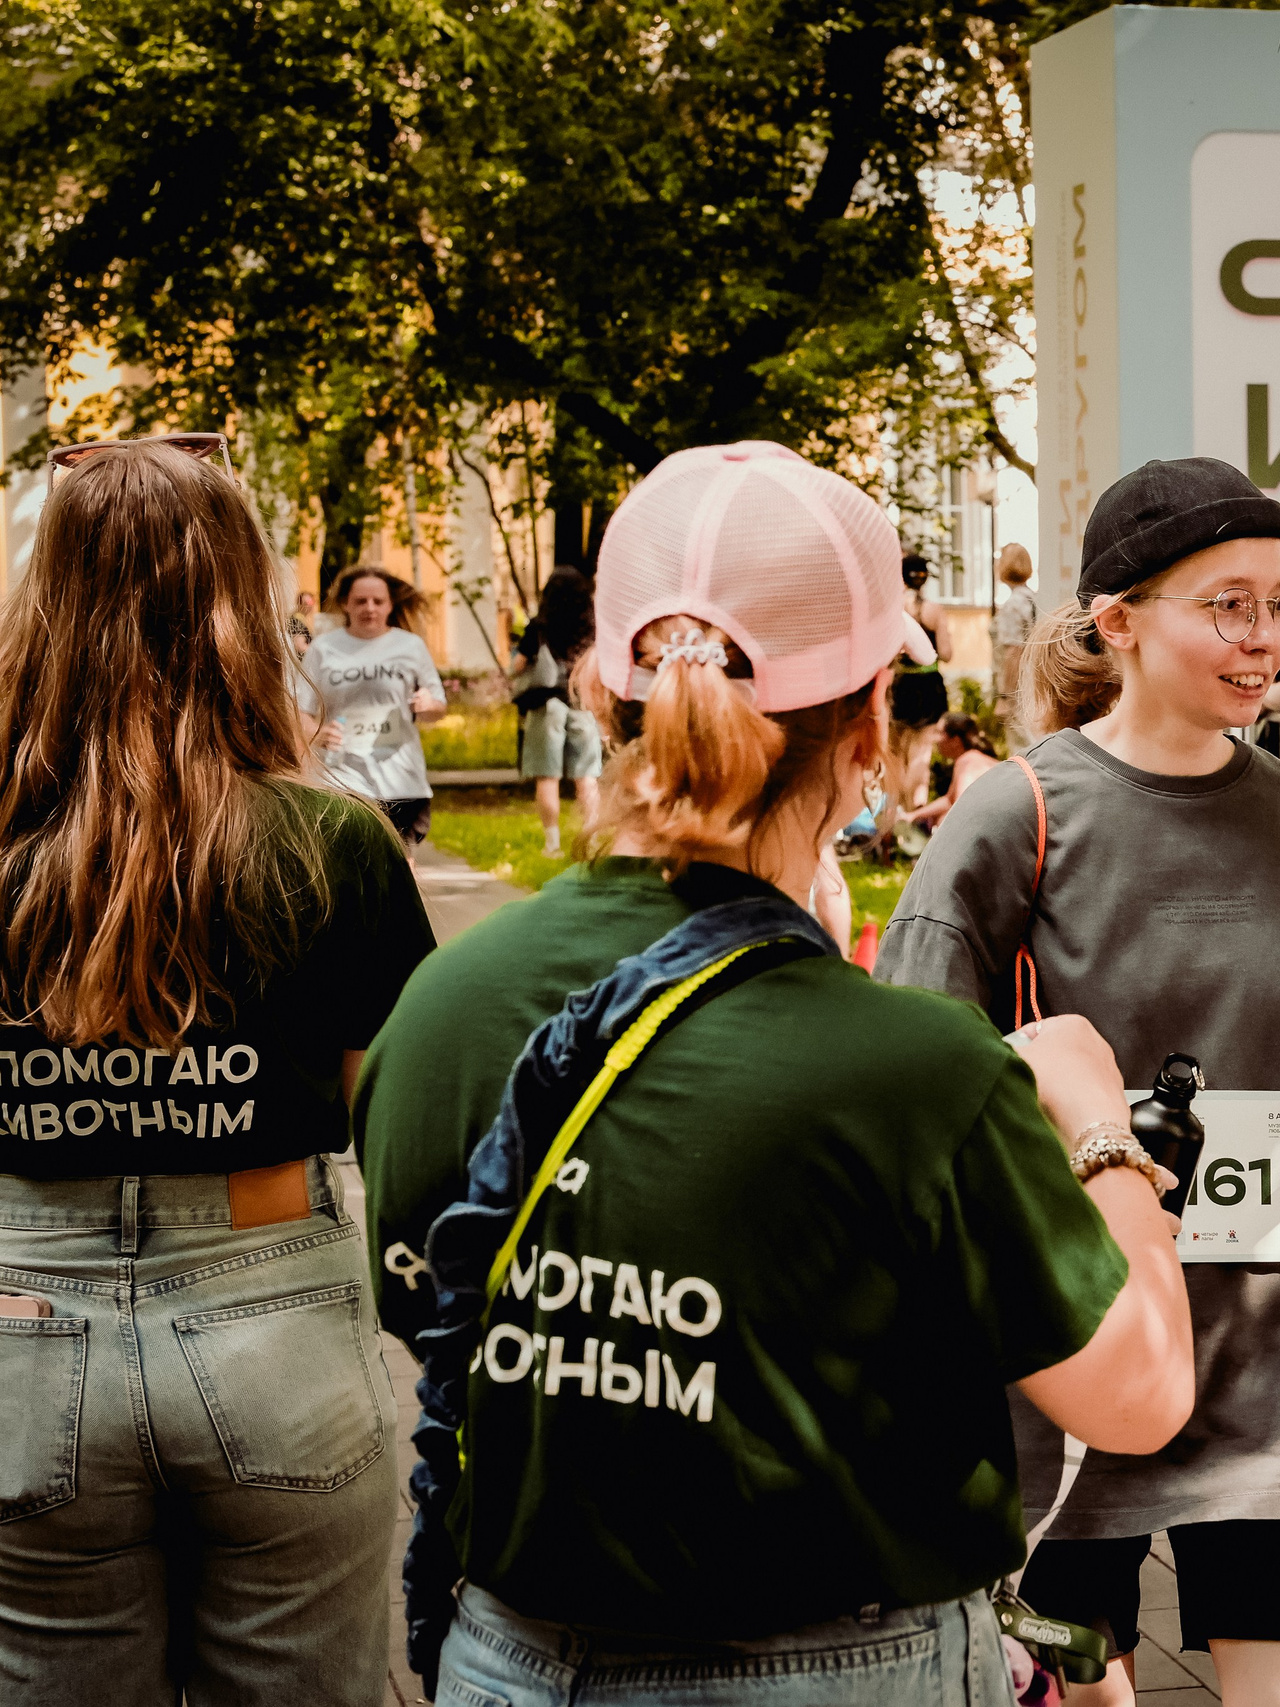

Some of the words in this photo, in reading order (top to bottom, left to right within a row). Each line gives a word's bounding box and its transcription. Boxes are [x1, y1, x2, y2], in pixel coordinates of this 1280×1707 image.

[0, 1098, 255, 1141] ИВОТНЫМ
[1268, 1112, 1275, 1120] 8
[502, 1245, 722, 1337] МОГАЮ
